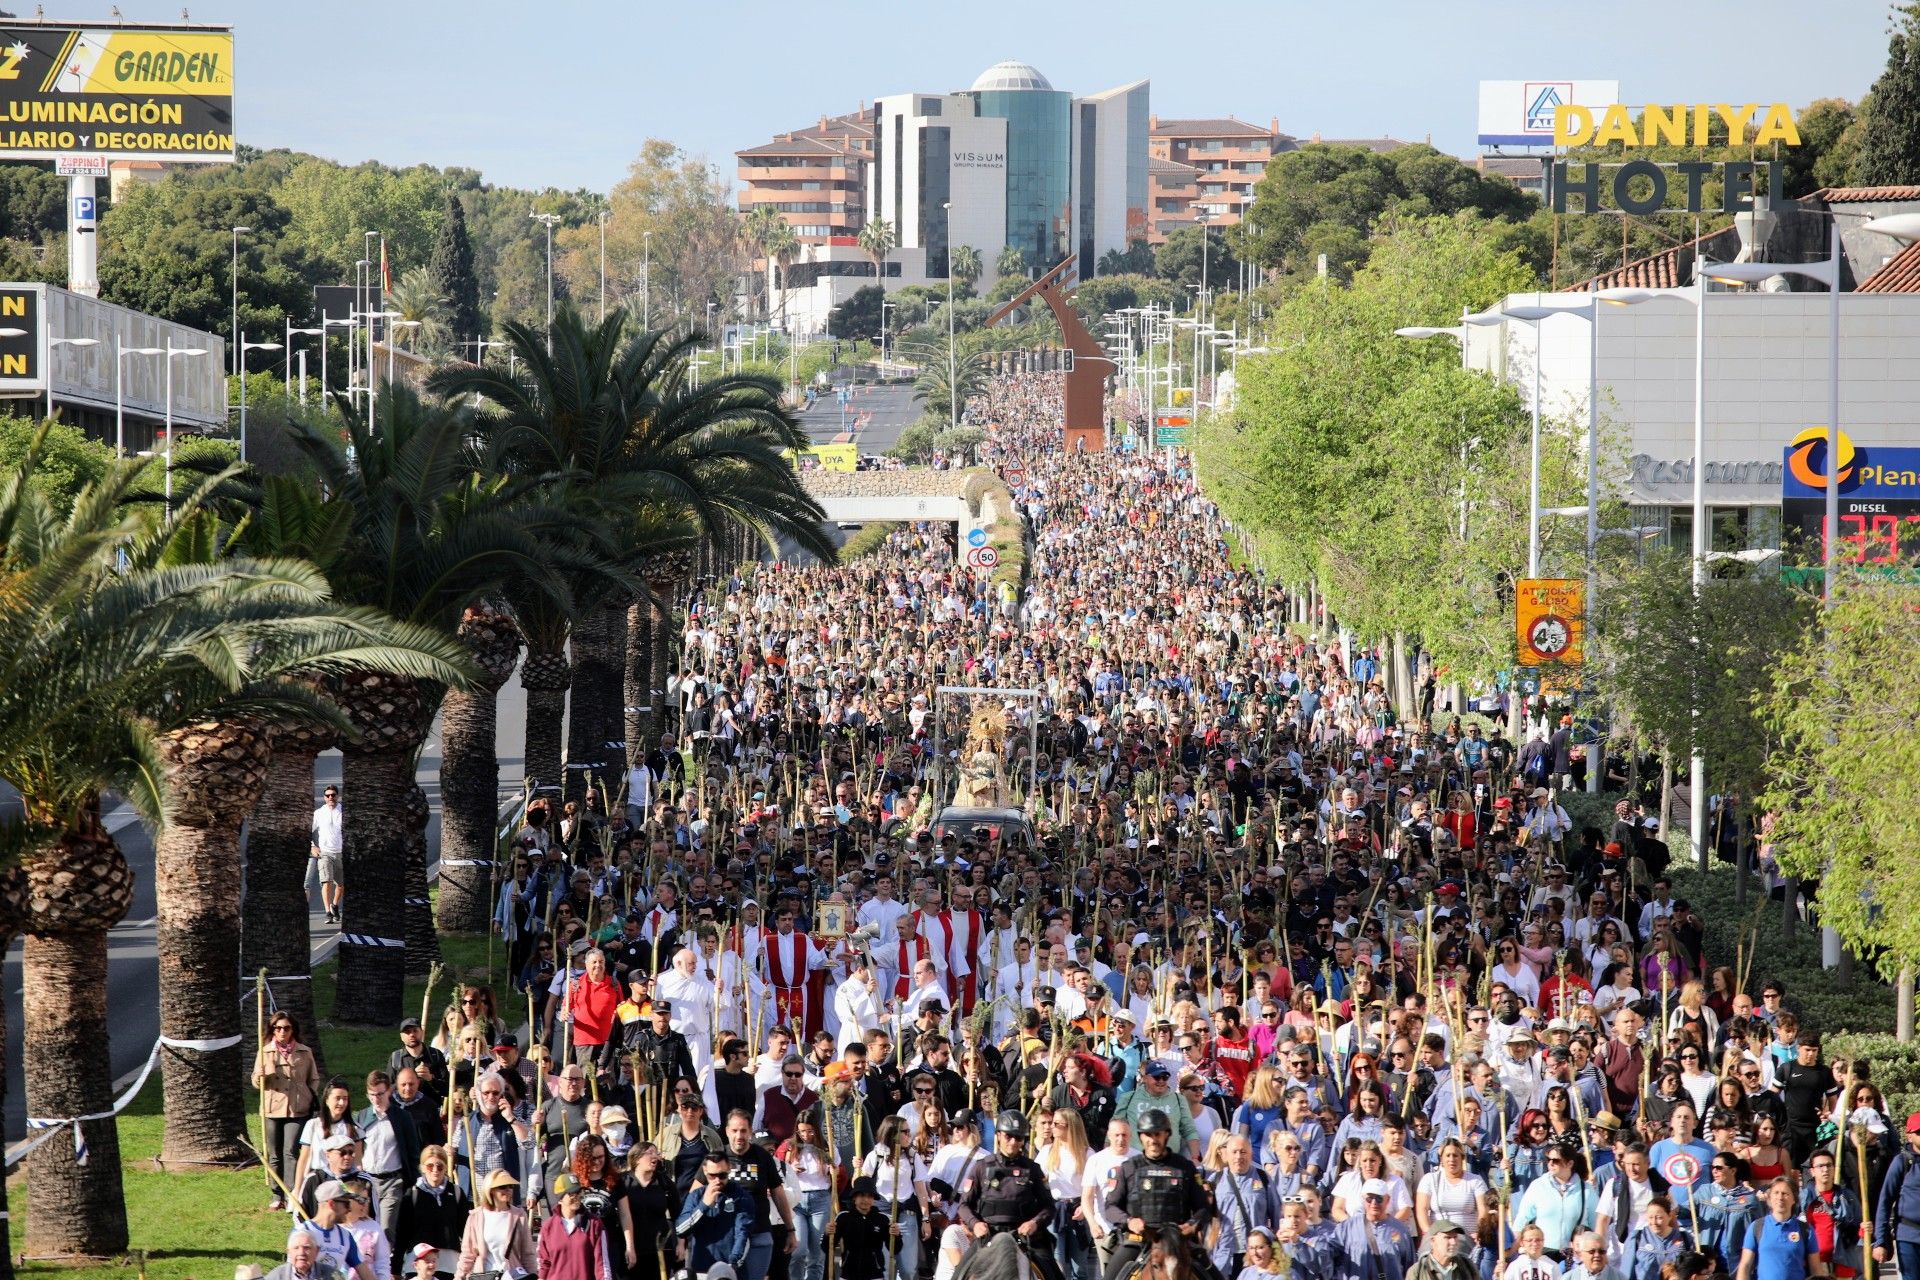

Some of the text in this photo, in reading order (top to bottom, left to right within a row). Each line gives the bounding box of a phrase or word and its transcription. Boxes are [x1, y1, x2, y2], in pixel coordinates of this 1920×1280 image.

[114, 50, 218, 82] GARDEN
[1529, 118, 1556, 130] AL
[1554, 104, 1802, 146] DANIYA
[78, 135, 89, 147] Y
[95, 130, 233, 150] DECORACIÓN
[953, 152, 1004, 162] VISSUM
[1552, 160, 1797, 215] HOTEL
[77, 199, 92, 218] P
[0, 353, 27, 375] N
[824, 456, 844, 464] DYA
[1858, 464, 1920, 487] Plen
[1849, 503, 1888, 513] DIESEL
[981, 553, 994, 562] 50
